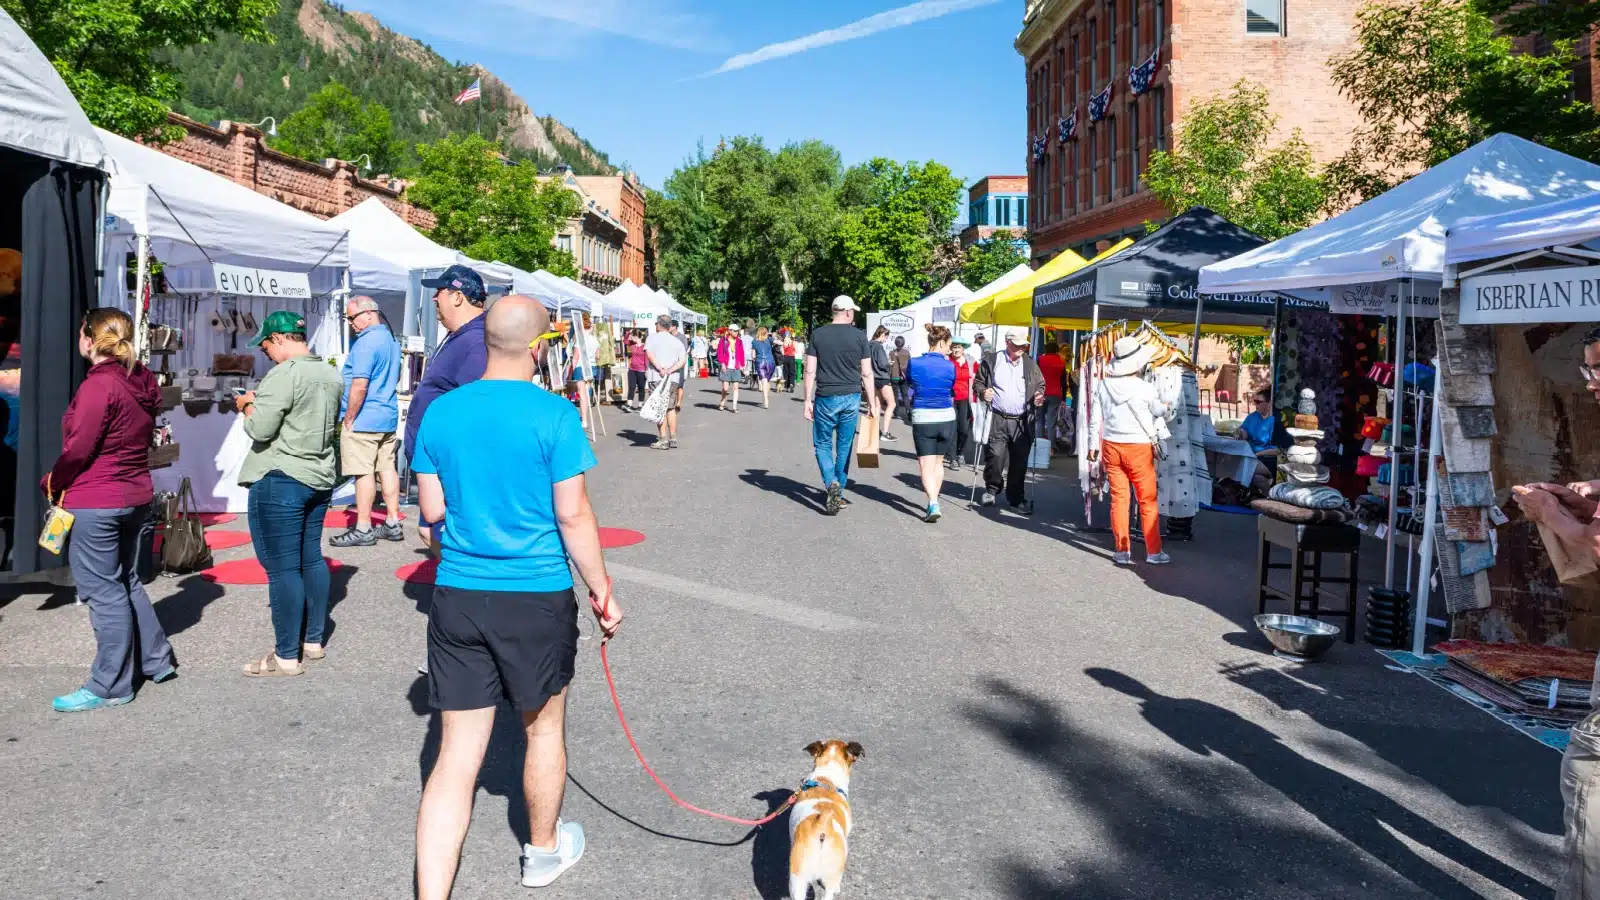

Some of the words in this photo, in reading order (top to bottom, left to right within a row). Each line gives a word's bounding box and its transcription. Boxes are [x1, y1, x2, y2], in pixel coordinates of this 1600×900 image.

[220, 269, 278, 295] evoke
[282, 287, 307, 296] women
[1356, 285, 1371, 297] Jill
[1167, 284, 1229, 301] Coldell
[1233, 293, 1276, 304] Banke
[1390, 295, 1419, 305] TALE
[1476, 281, 1572, 311] ISBERIAN
